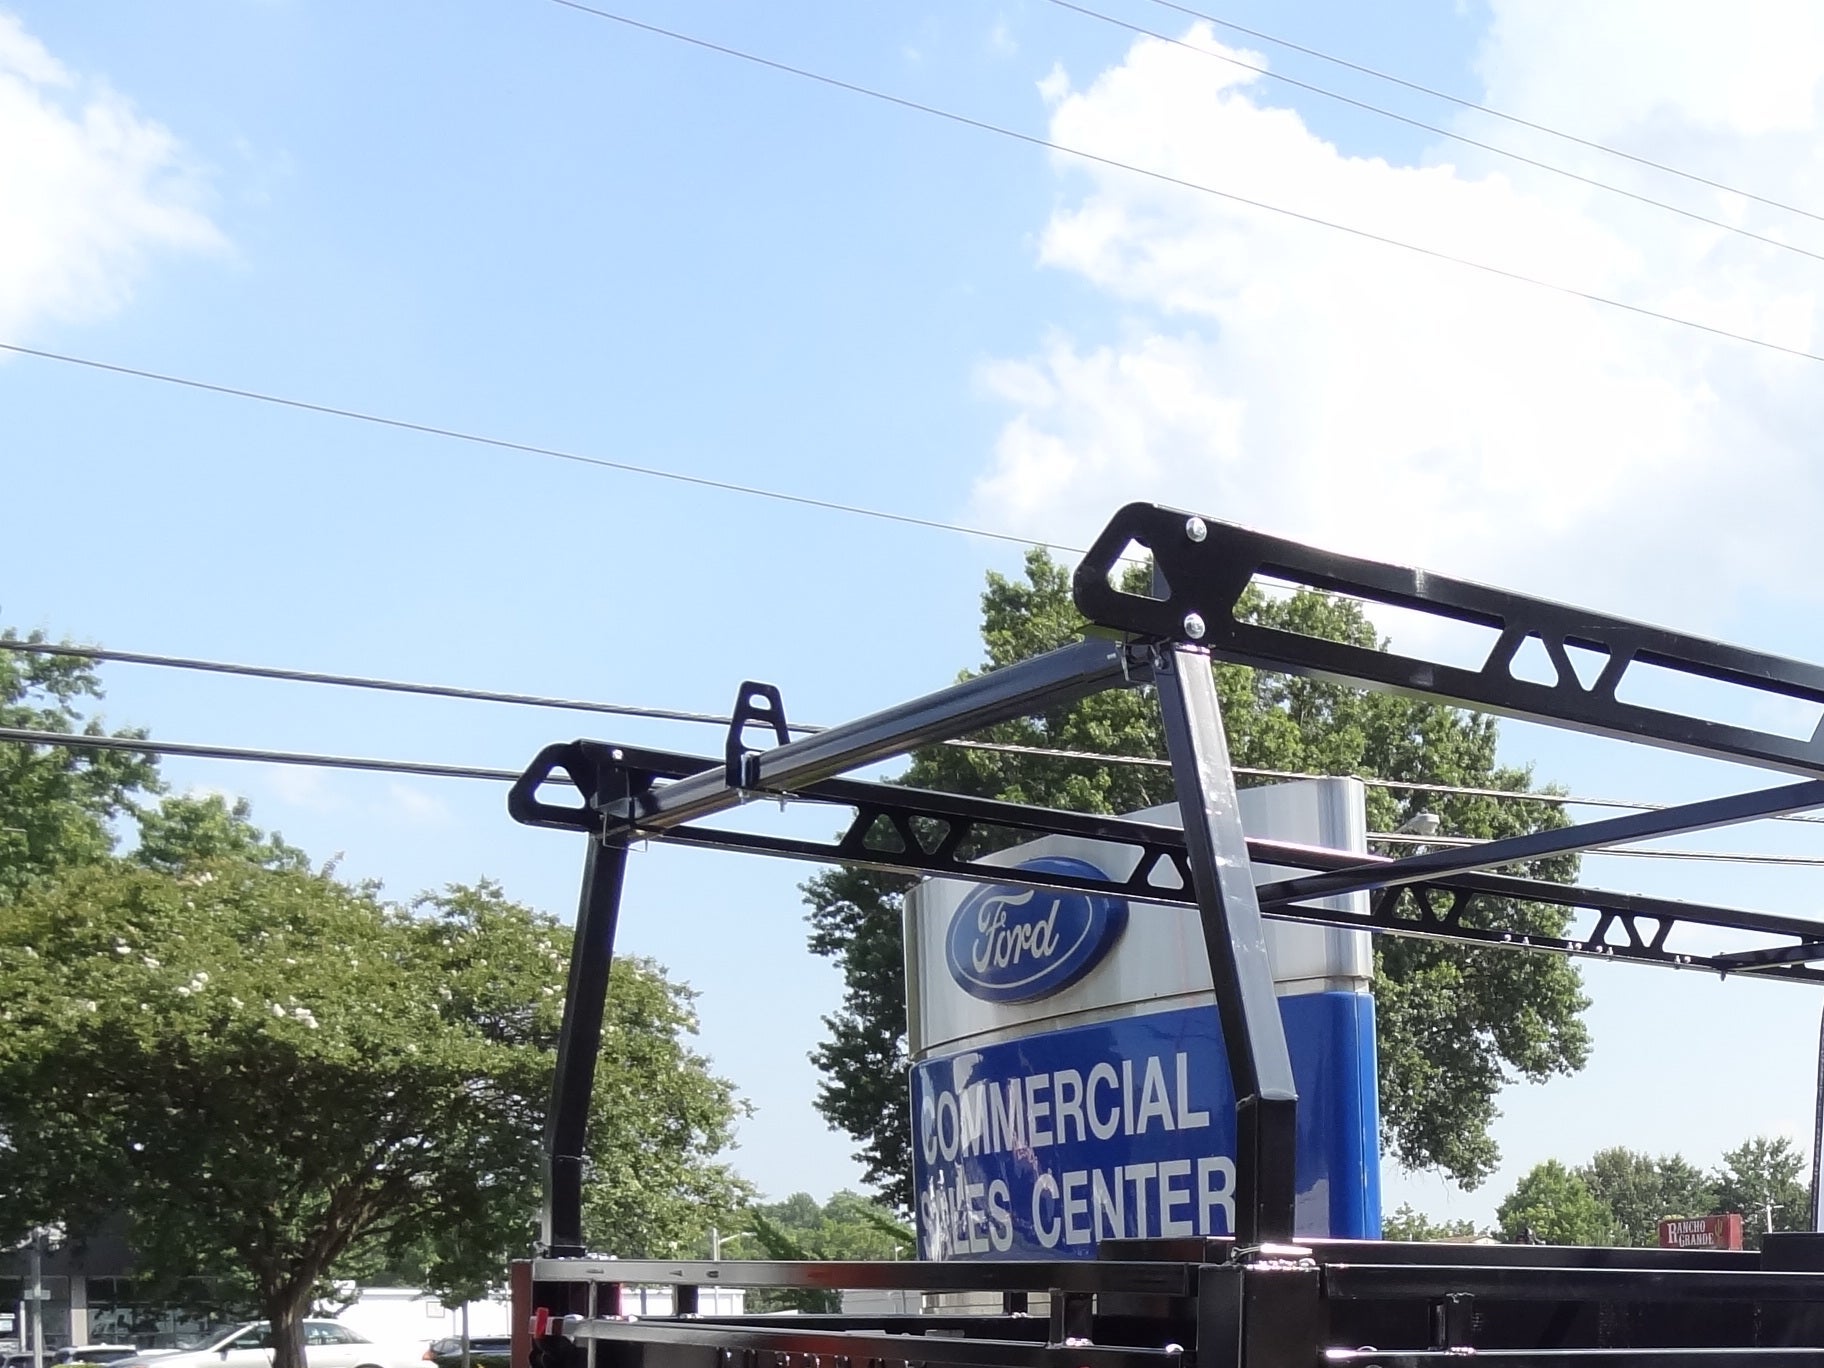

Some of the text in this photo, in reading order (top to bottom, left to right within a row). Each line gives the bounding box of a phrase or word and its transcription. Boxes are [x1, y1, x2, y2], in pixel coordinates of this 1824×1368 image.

[971, 888, 1061, 973] Ford
[920, 1051, 1211, 1166] COMMERCIAL
[920, 1155, 1237, 1259] SALES CENTER
[1667, 1220, 1706, 1244] RANCHO
[1679, 1232, 1715, 1248] GRANDE
